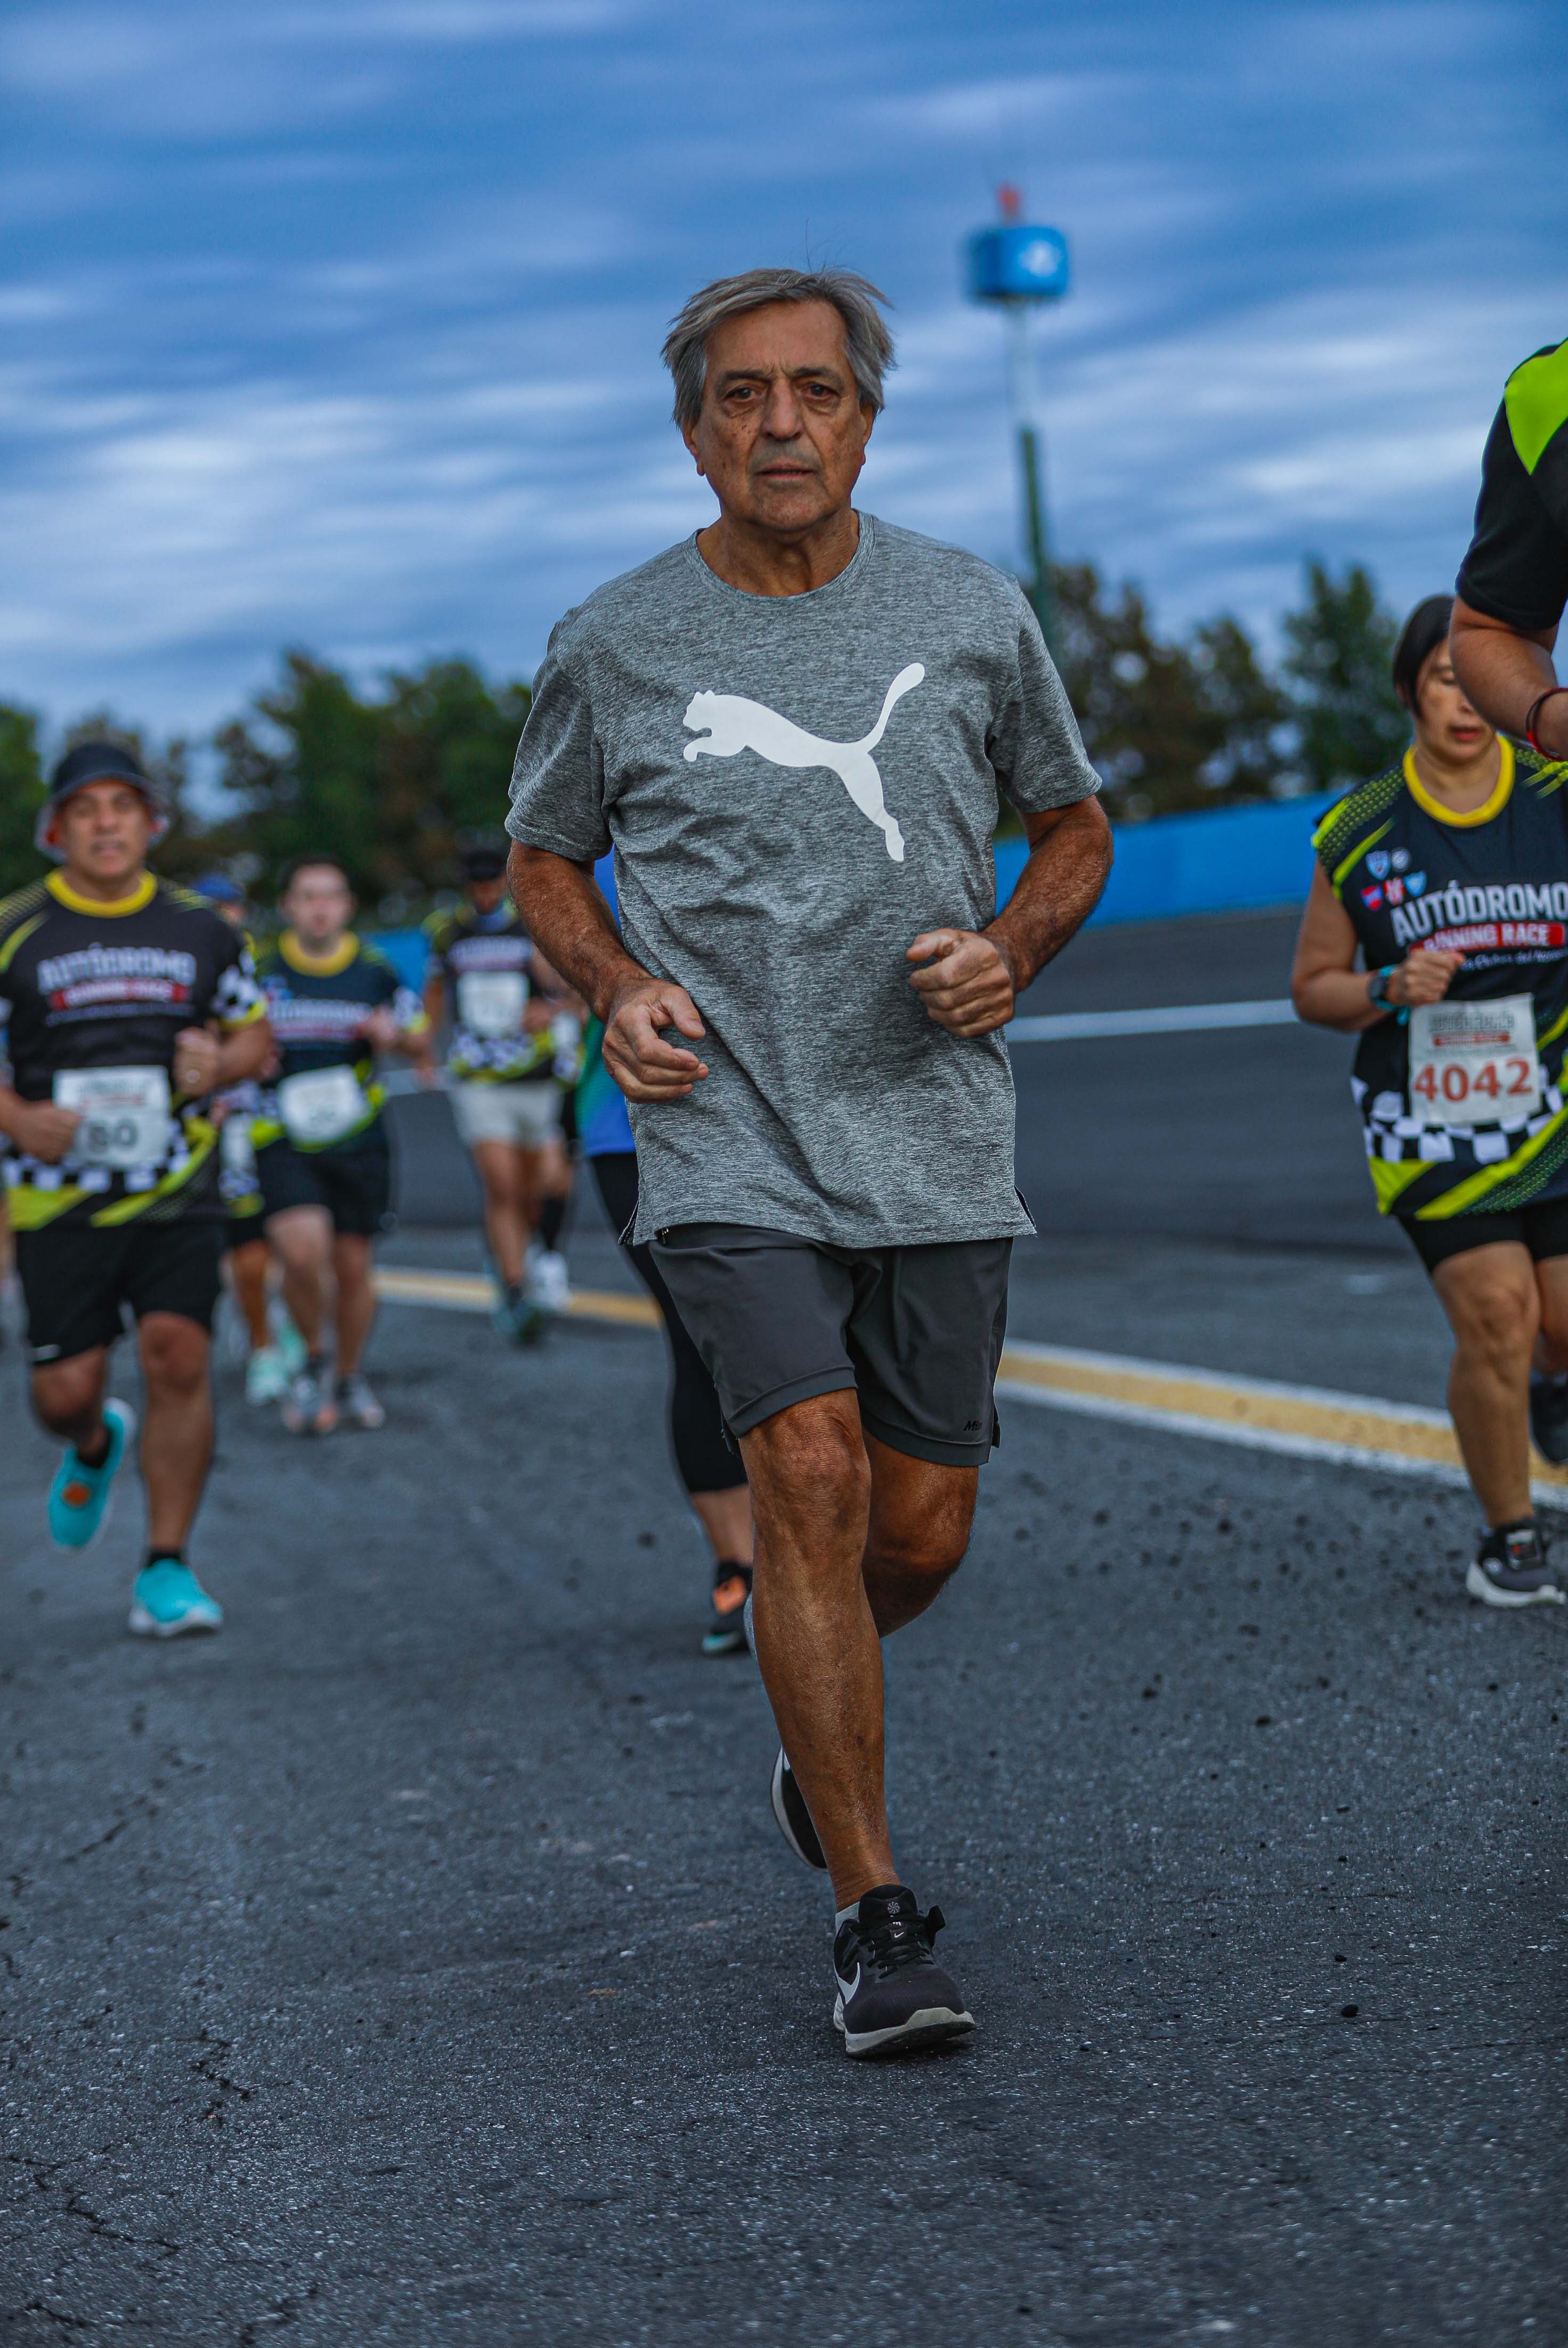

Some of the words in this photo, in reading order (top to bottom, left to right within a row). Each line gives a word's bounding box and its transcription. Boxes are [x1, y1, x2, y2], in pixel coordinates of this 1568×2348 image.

[1390, 880, 1568, 946] AUTÓDROMO
[1501, 922, 1549, 947] RACE
[1413, 1057, 1533, 1102] 4042
